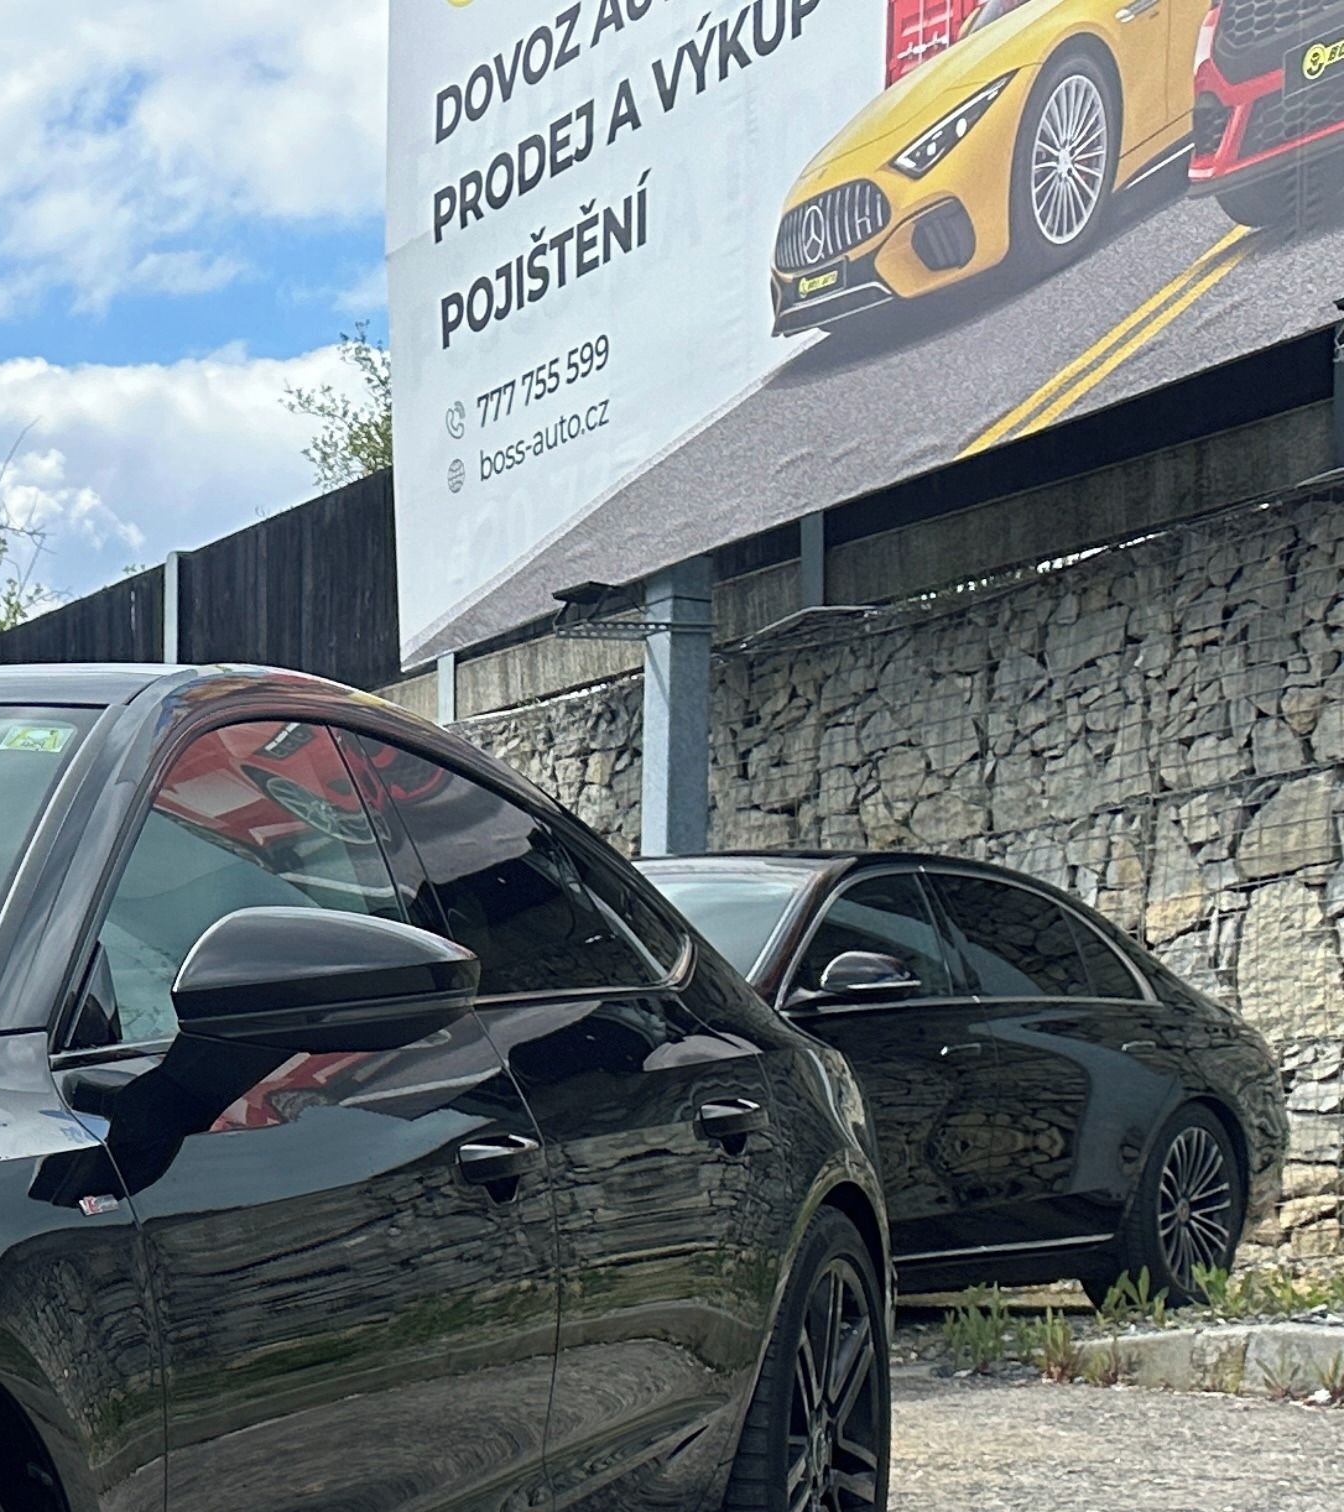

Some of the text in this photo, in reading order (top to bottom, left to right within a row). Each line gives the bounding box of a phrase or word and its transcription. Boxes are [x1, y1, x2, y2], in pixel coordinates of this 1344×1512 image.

[434, 99, 595, 244] PRODEJ
[607, 78, 642, 146] A
[652, 0, 819, 113] VÝKUP
[436, 2, 580, 145] DOVOZ
[441, 168, 652, 349] POJIŠTĚNÍ
[477, 334, 610, 428] 777 755 599
[479, 399, 610, 481] boss-auto.cz
